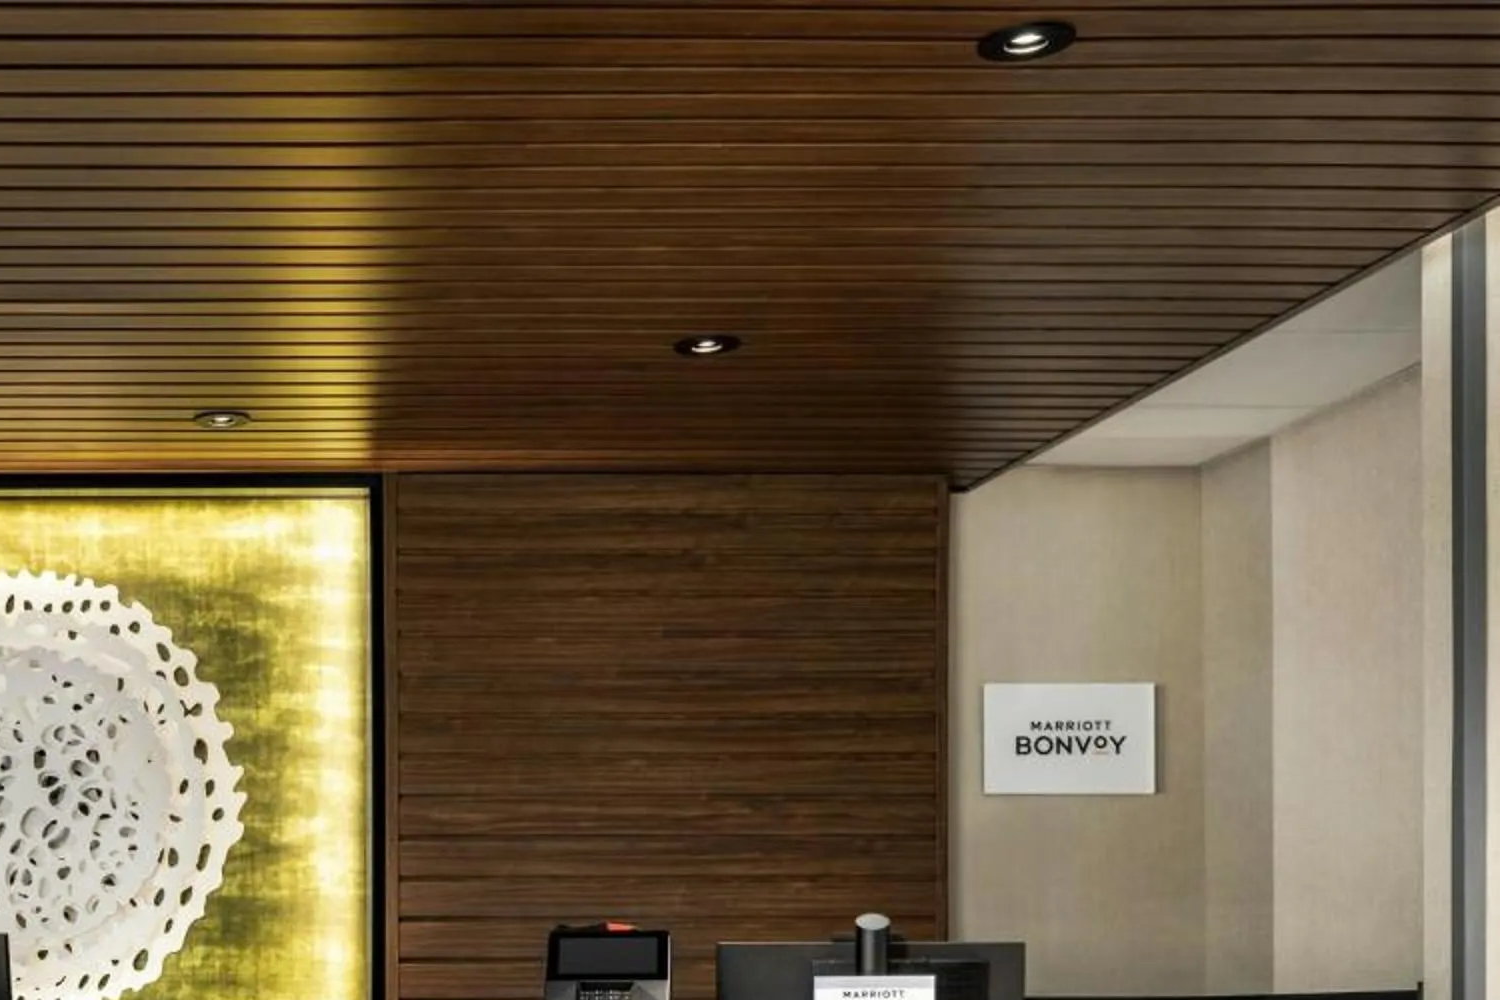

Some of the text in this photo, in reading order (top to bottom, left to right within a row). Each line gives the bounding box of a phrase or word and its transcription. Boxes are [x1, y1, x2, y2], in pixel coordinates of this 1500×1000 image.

[1029, 720, 1112, 731] MARRIOTT
[1015, 735, 1127, 755] BONVOY
[842, 990, 906, 999] MARRIOTT
